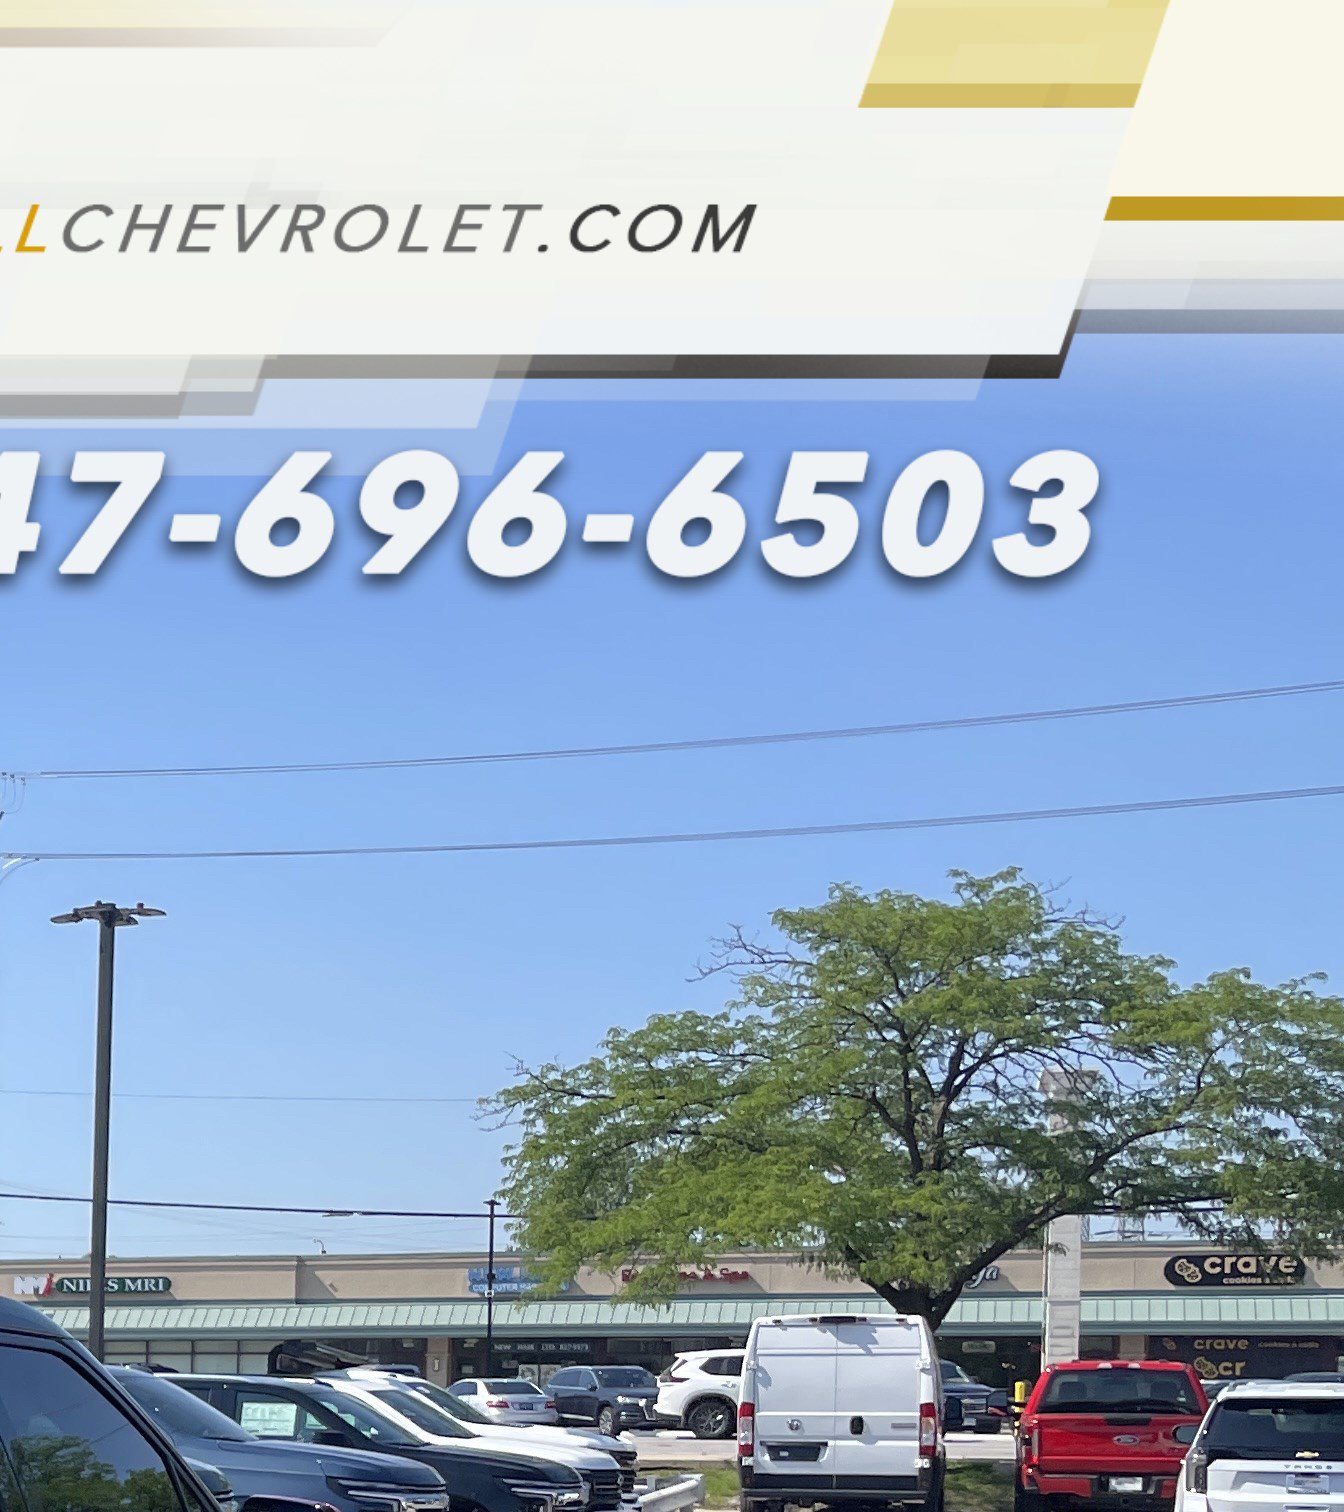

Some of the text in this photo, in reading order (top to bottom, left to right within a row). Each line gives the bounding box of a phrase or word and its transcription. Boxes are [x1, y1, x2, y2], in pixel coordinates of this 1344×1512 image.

[1204, 1255, 1297, 1275] crave
[63, 1278, 164, 1292] NIS MRI
[1194, 1338, 1249, 1350] crave
